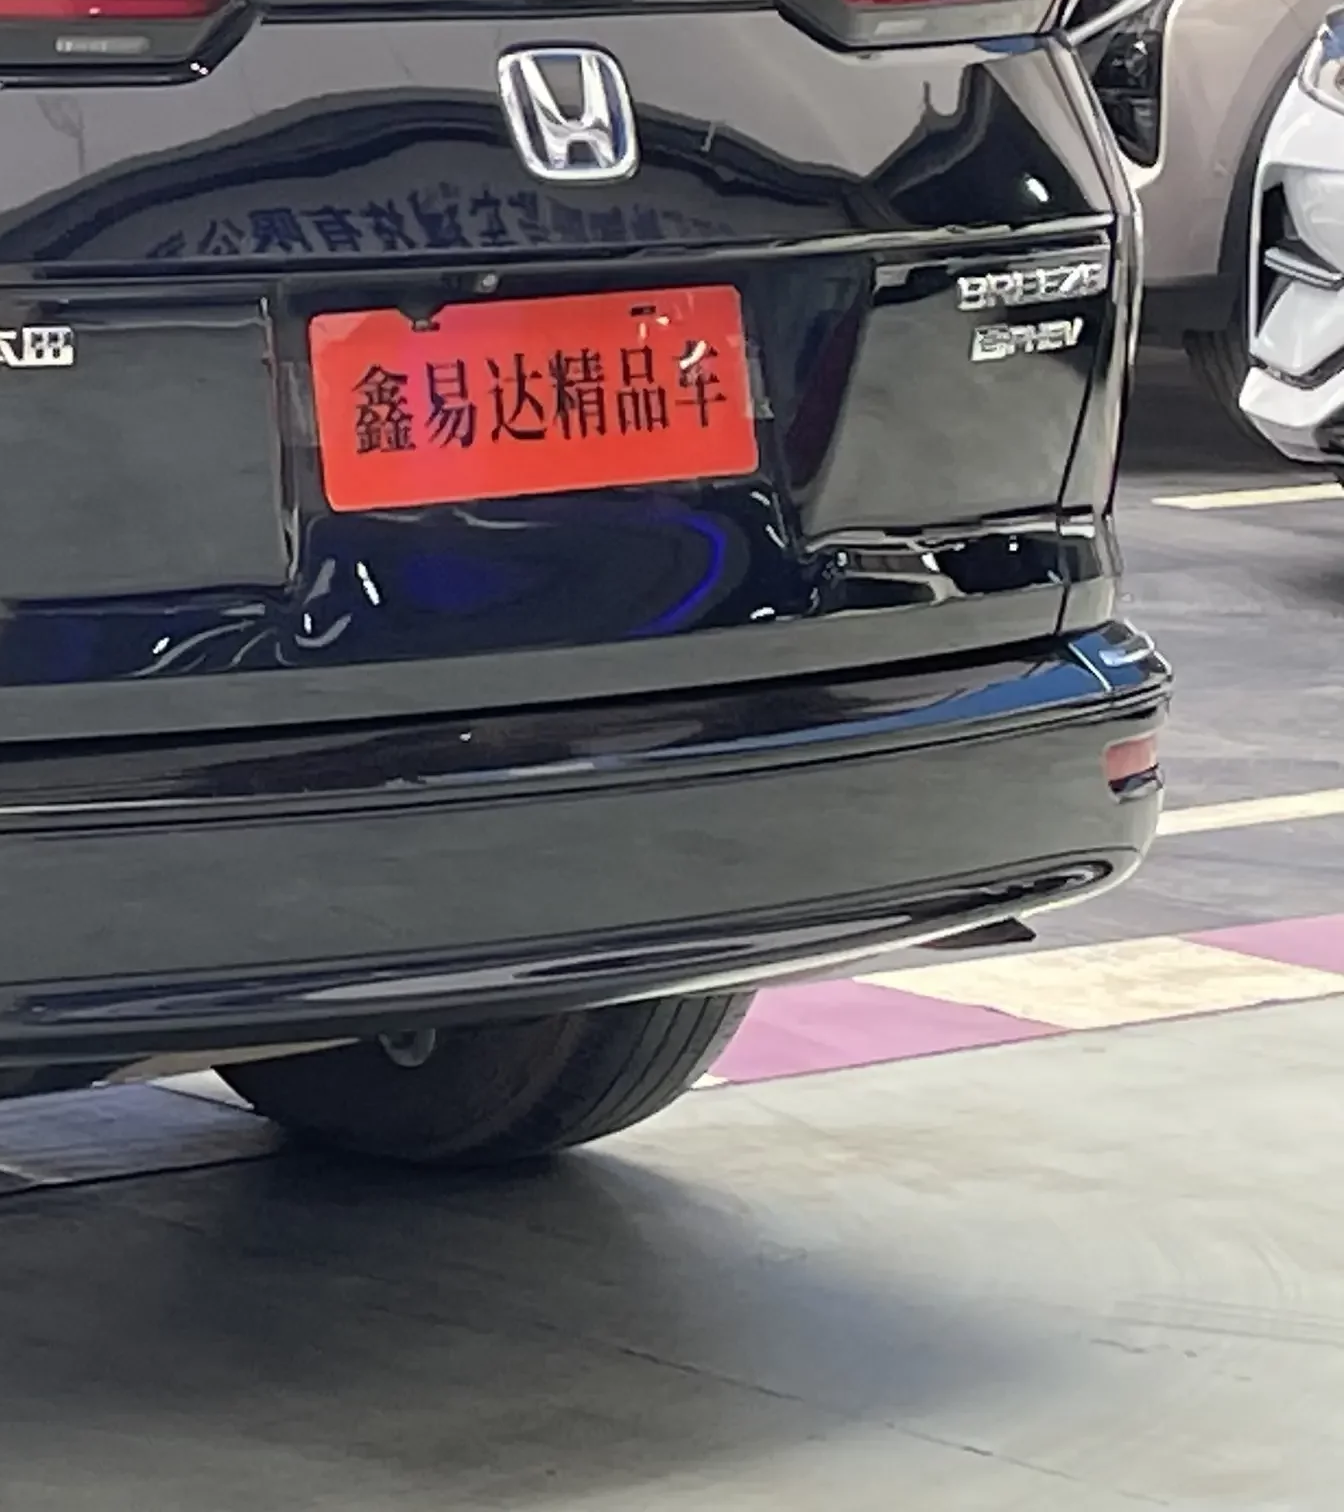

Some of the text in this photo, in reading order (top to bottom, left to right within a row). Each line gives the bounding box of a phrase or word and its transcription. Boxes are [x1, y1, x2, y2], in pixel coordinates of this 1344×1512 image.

[352, 339, 728, 456] 鑫易达精品车
